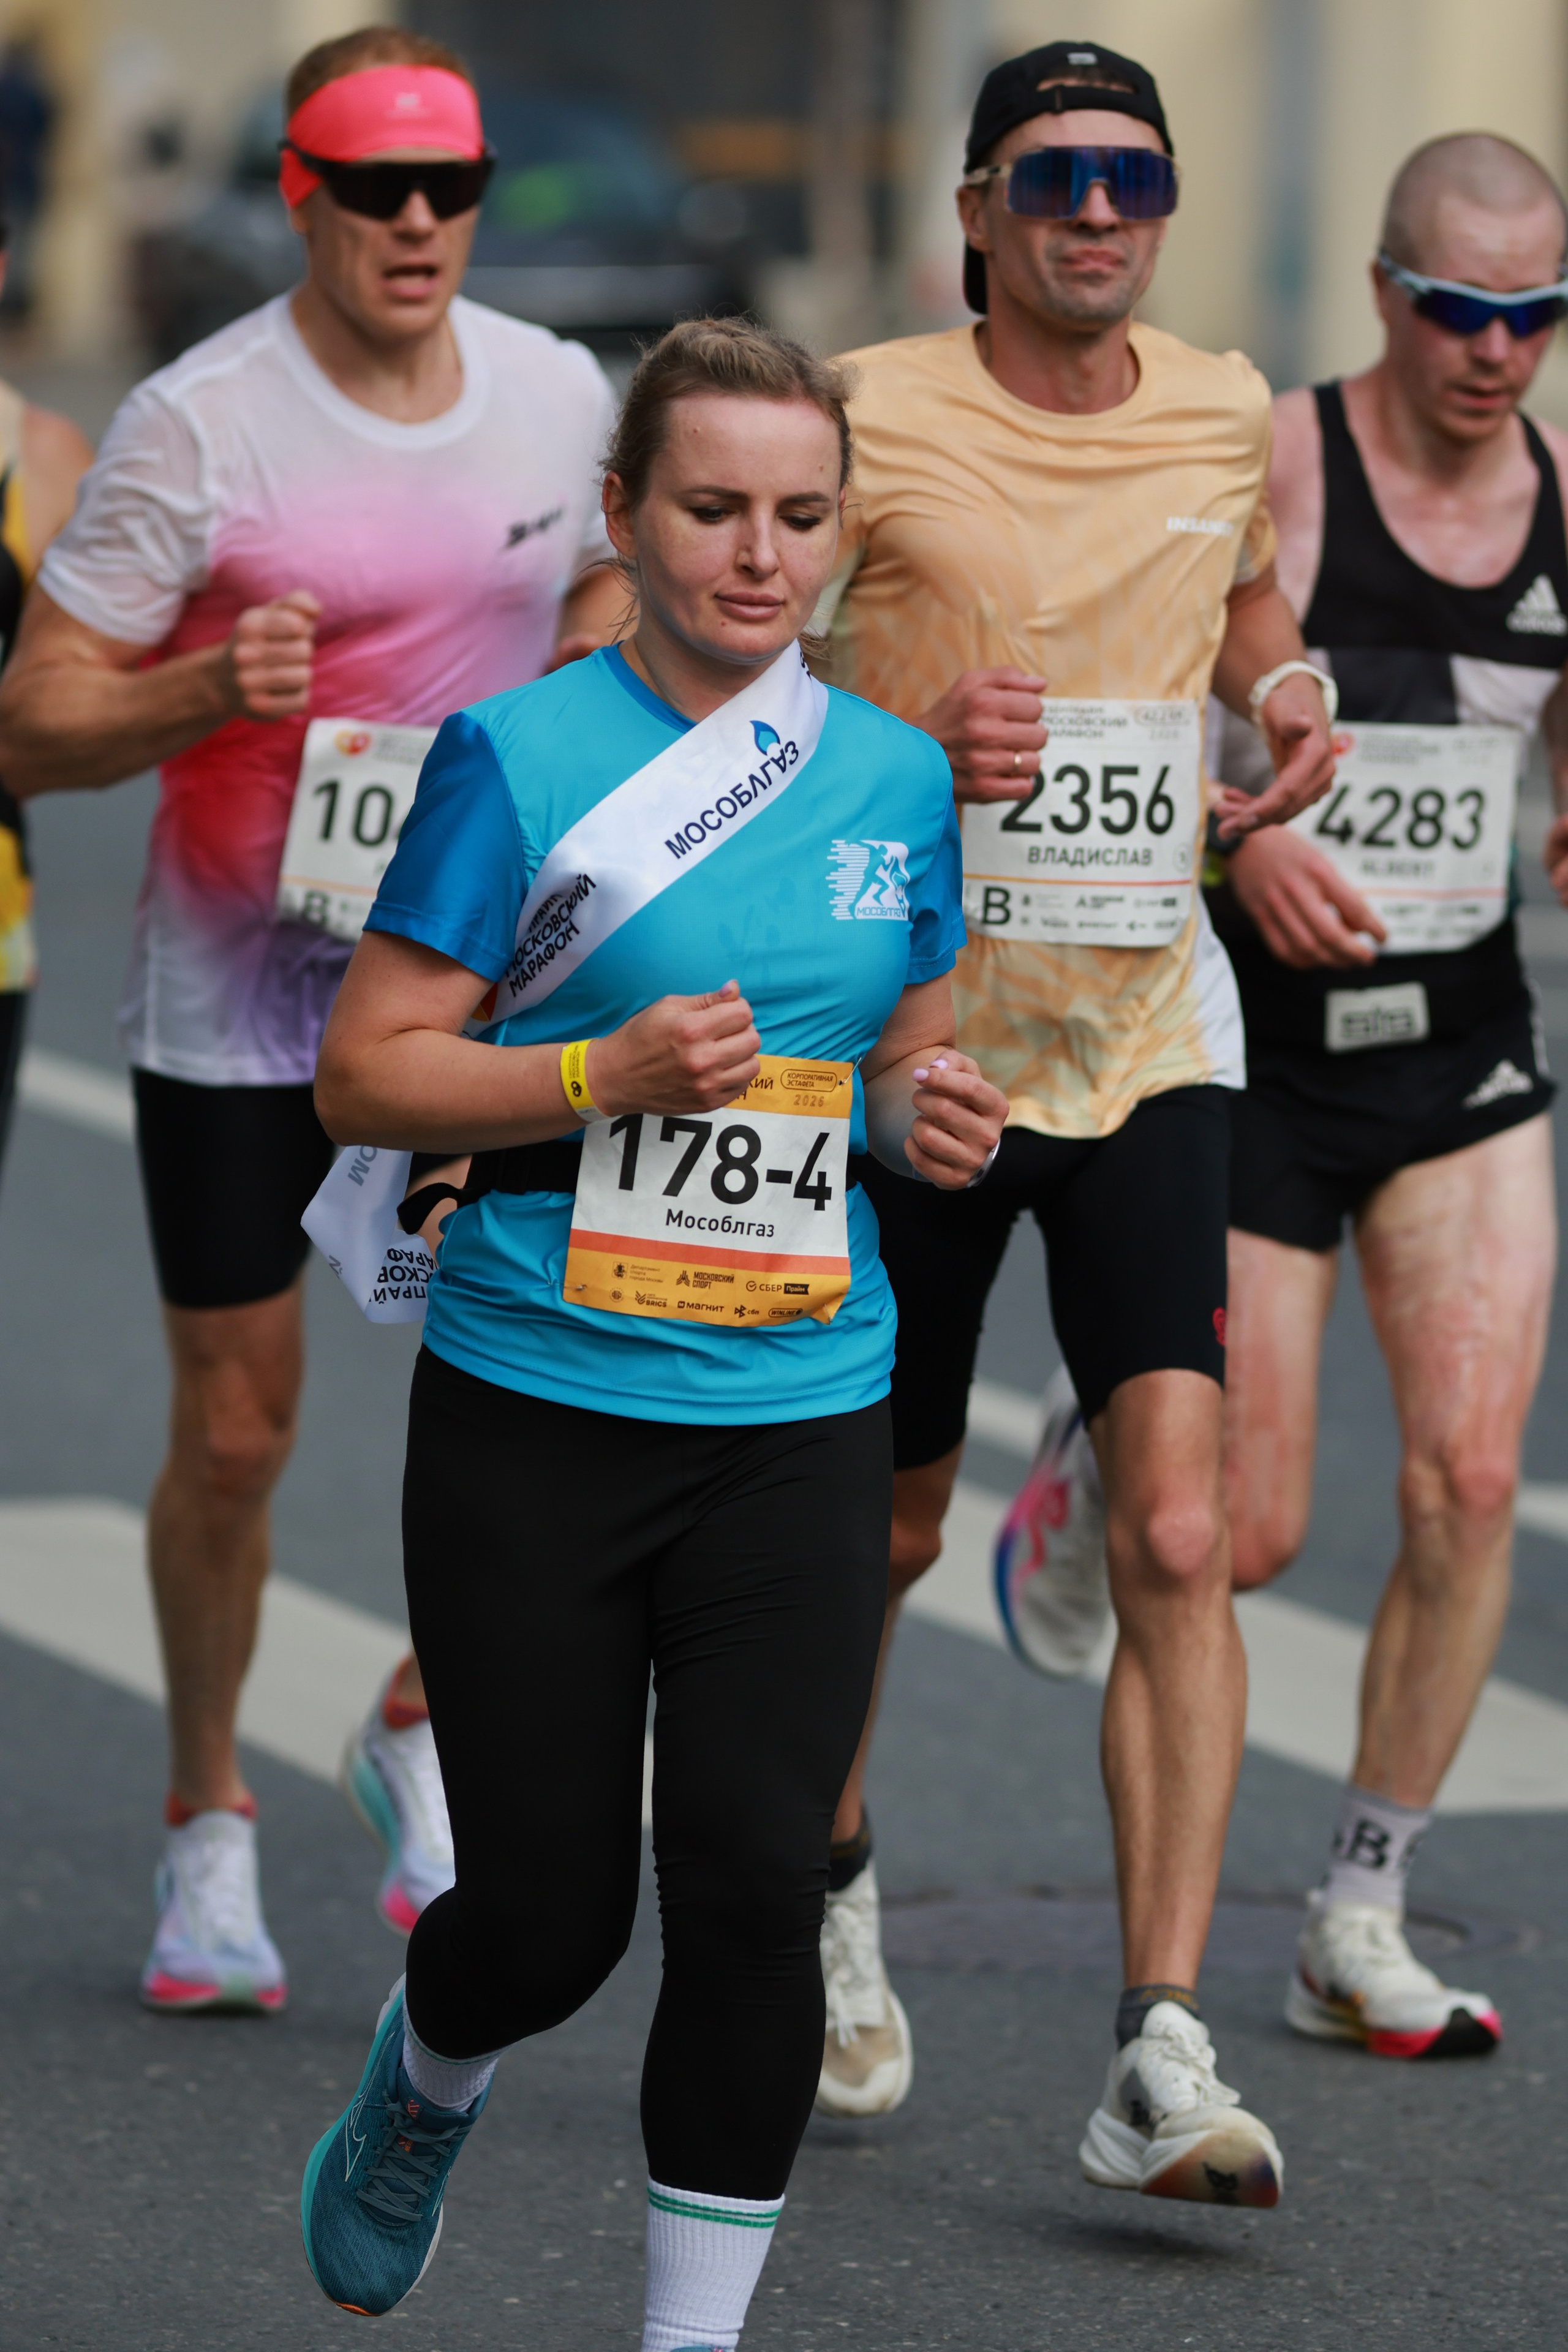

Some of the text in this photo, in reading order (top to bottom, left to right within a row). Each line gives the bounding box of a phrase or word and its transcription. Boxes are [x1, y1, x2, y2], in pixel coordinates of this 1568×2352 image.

[664, 741, 799, 859] МОСОБЛГАЗ
[1000, 764, 1174, 837] 2356
[312, 778, 408, 848] 10
[1315, 785, 1486, 851] 4283
[1027, 845, 1153, 867] ВЛАДИСЛАВ
[509, 921, 579, 997] МАРАФОН
[786, 1079, 815, 1088] ЭСТАФЕТА
[787, 1072, 834, 1082] КОРПОРАТИВНАЯ
[793, 1093, 825, 1107] 2026
[609, 1112, 832, 1212] 178-4
[665, 1208, 775, 1238] Мособлгаз
[386, 1248, 439, 1271] АРАФ
[692, 1280, 712, 1289] СПОРТ
[693, 1271, 734, 1284] МОСКОВСКИЙ
[759, 1283, 782, 1292] СБЕР
[369, 1286, 426, 1305] ПРАЙ
